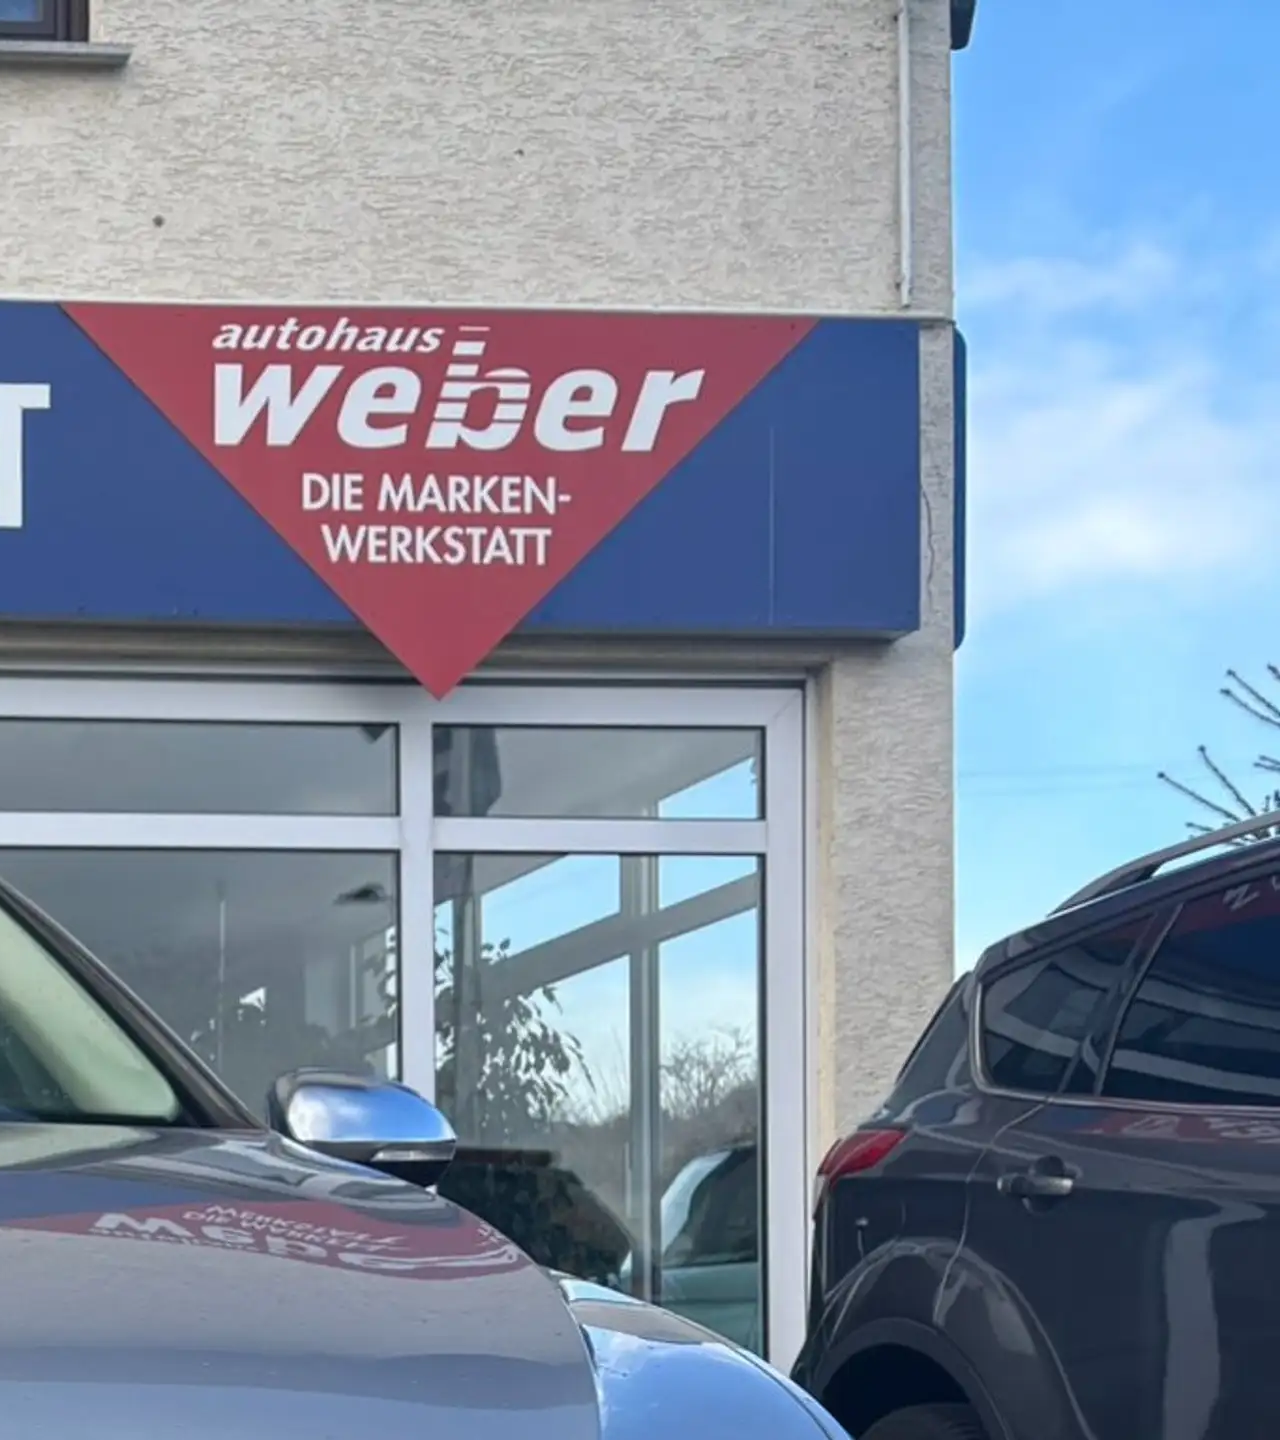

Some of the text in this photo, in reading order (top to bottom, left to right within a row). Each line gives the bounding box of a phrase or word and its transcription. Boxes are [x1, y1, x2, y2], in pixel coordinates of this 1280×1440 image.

[212, 316, 444, 353] autohaus
[212, 325, 706, 452] weber
[301, 472, 572, 516] DIE MARKEN-
[320, 523, 553, 566] WERKSTATT
